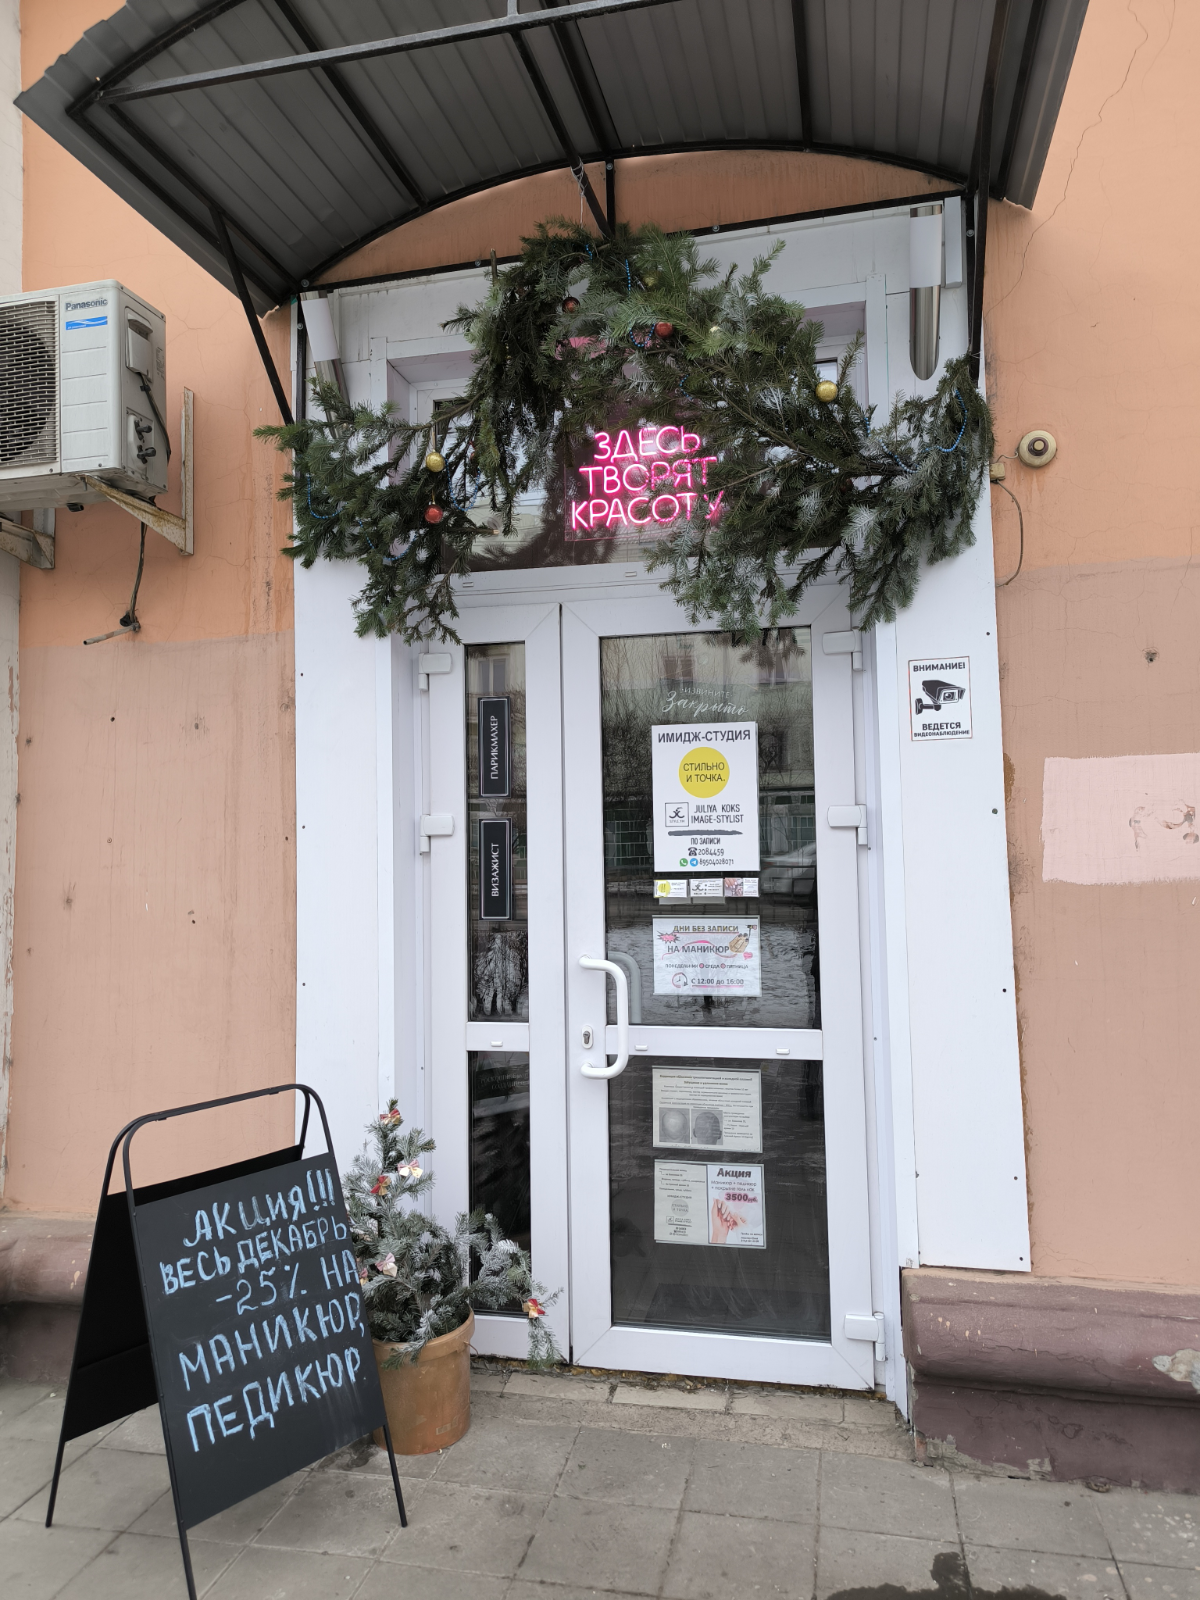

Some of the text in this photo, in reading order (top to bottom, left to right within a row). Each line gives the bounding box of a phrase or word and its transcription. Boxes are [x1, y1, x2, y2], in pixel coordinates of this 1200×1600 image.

[65, 298, 108, 311] Panasonic
[593, 426, 701, 464] ЗДЕСЬ
[578, 456, 717, 496] ТВОРЯТ
[571, 491, 725, 530] КРАСОТУ
[913, 662, 966, 672] ВНИМАНИЕ!
[662, 690, 749, 717] Закрыто
[922, 722, 962, 731] ВЕДЕТСЯ
[658, 729, 751, 744] ИМИДЖ-СТУДИЯ
[914, 730, 970, 738] ВИДЕОНАБЛЮДЕНИЕ
[490, 715, 499, 780] ПАРИКМАХЕР
[683, 762, 725, 772] СТИЛЬНО
[686, 774, 692, 783] И
[694, 803, 741, 813] JULIYA KOKS
[691, 814, 744, 824] IMAGE-STYLIST
[699, 837, 721, 845] ЗАПИСИ
[698, 848, 725, 857] 2084459
[491, 842, 499, 897] ВИЗАЖИСТ
[673, 925, 690, 933] ДНИ
[667, 945, 730, 954] НА МАНИКЮР
[716, 1167, 752, 1178] Акция
[183, 1168, 336, 1248] АКЦИЯ!!!
[160, 1215, 348, 1295] ВЕСЬ ДЕКАБРЬ
[320, 1250, 360, 1290] НА
[179, 1292, 365, 1392] МАНИКЮР,
